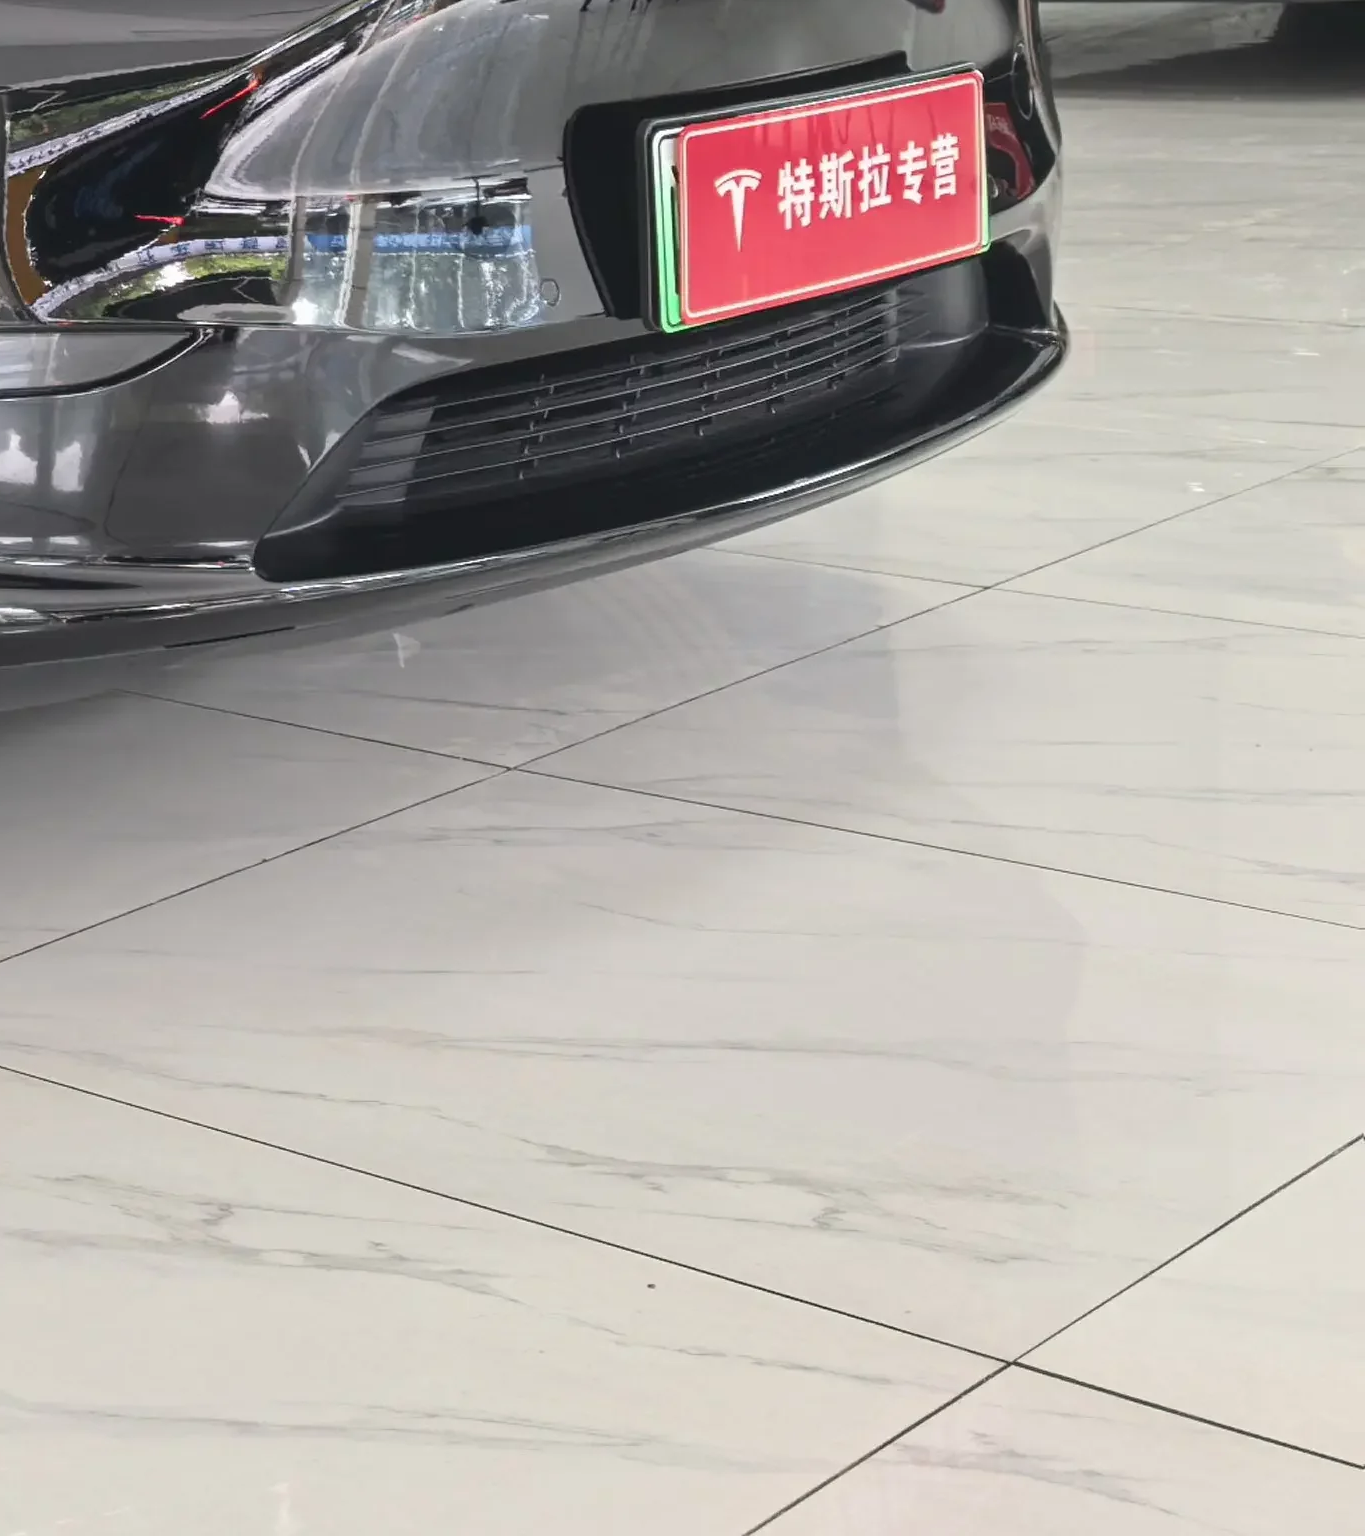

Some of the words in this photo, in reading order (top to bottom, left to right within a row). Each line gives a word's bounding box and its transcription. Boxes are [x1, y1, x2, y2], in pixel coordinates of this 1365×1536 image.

[777, 132, 961, 231] 特斯拉专营
